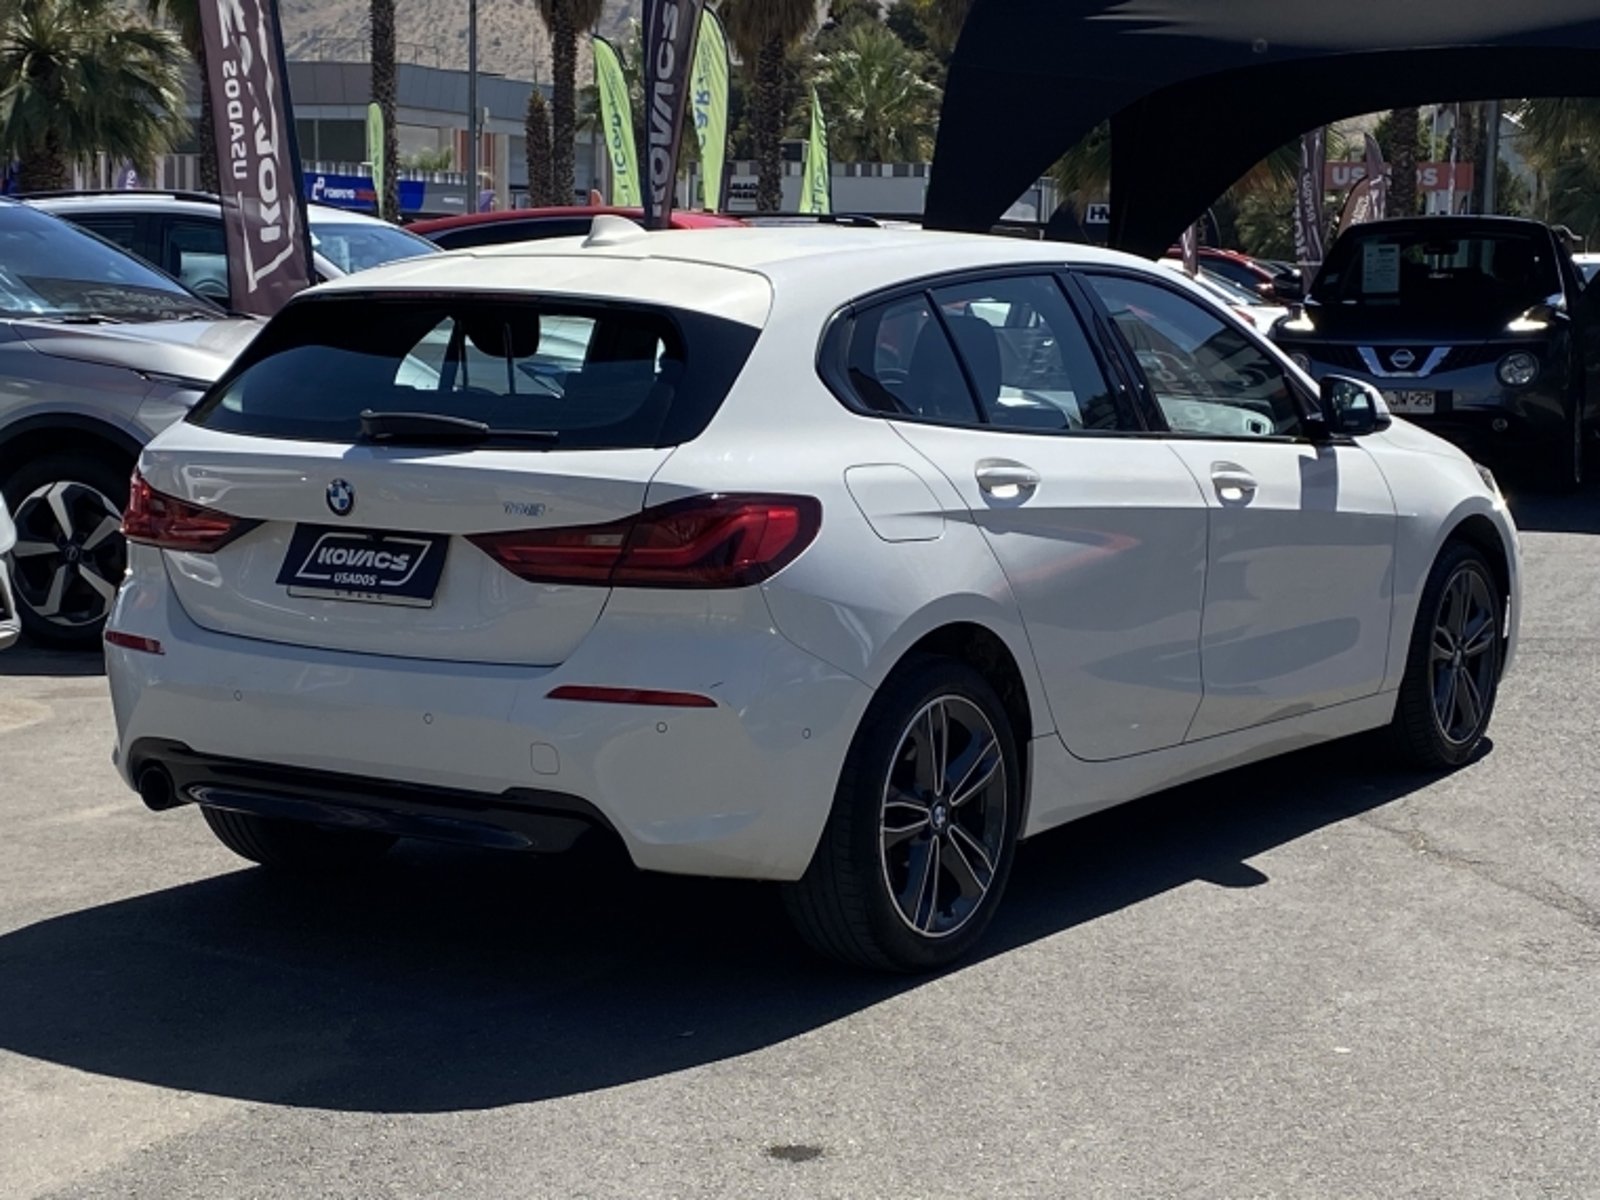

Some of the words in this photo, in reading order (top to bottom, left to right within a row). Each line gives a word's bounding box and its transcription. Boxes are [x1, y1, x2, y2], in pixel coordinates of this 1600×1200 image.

[649, 2, 678, 218] KOVACS
[1331, 166, 1438, 186] USS
[317, 546, 411, 571] KOVACS
[333, 571, 378, 587] USADOS
